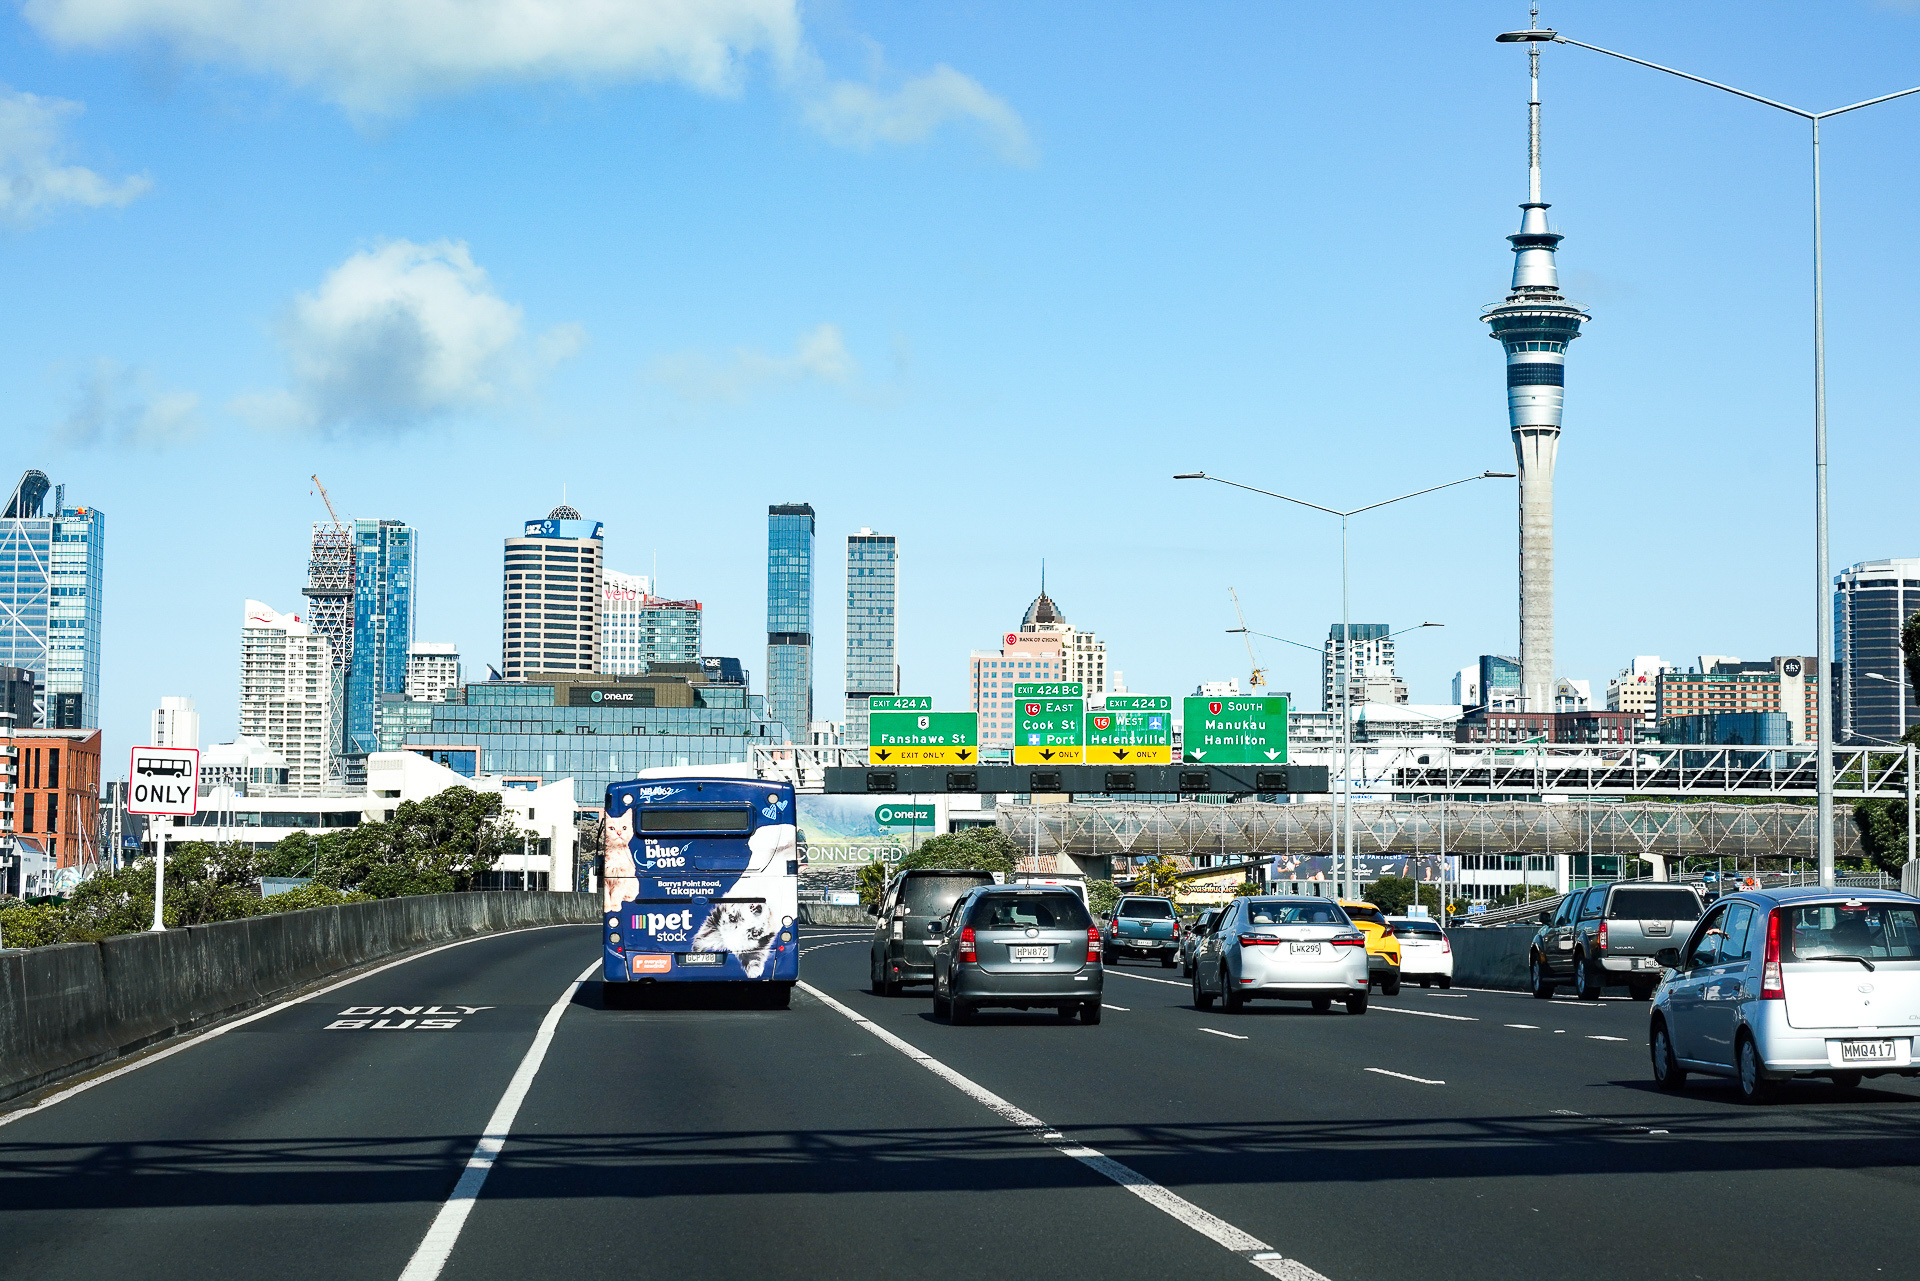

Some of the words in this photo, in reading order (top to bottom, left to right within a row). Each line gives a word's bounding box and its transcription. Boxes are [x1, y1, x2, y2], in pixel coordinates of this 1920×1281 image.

[605, 589, 636, 600] vero
[1037, 686, 1059, 694] 424
[604, 693, 634, 701] one.nz
[894, 699, 917, 708] 424
[919, 699, 928, 708] A
[1027, 705, 1038, 713] 16
[1046, 703, 1074, 712] EAST
[1132, 699, 1156, 708] 424
[1160, 699, 1168, 708] D
[1228, 702, 1263, 711] SOUTH
[1023, 720, 1054, 730] Cook
[1061, 720, 1075, 730] St
[1096, 718, 1108, 726] 16
[1116, 717, 1144, 726] WEST
[1205, 720, 1266, 730] Manukau
[881, 734, 945, 744] Fanshawe
[952, 734, 966, 743] St
[1046, 735, 1075, 744] Port
[1091, 734, 1166, 744] Helensville
[1204, 735, 1266, 745] Hamilton
[135, 785, 191, 804] ONLY
[894, 810, 928, 819] one.nz
[646, 845, 679, 859] blue
[656, 855, 686, 868] one
[658, 880, 682, 888] Barrys
[699, 880, 722, 888] Road,
[665, 887, 714, 897] Takapuna
[648, 910, 692, 936] pet
[657, 930, 687, 942] stock
[1017, 947, 1048, 956] HPW872
[337, 1006, 497, 1016] ONLY
[323, 1019, 462, 1030] BUS
[1843, 1044, 1892, 1057] MMQ417
